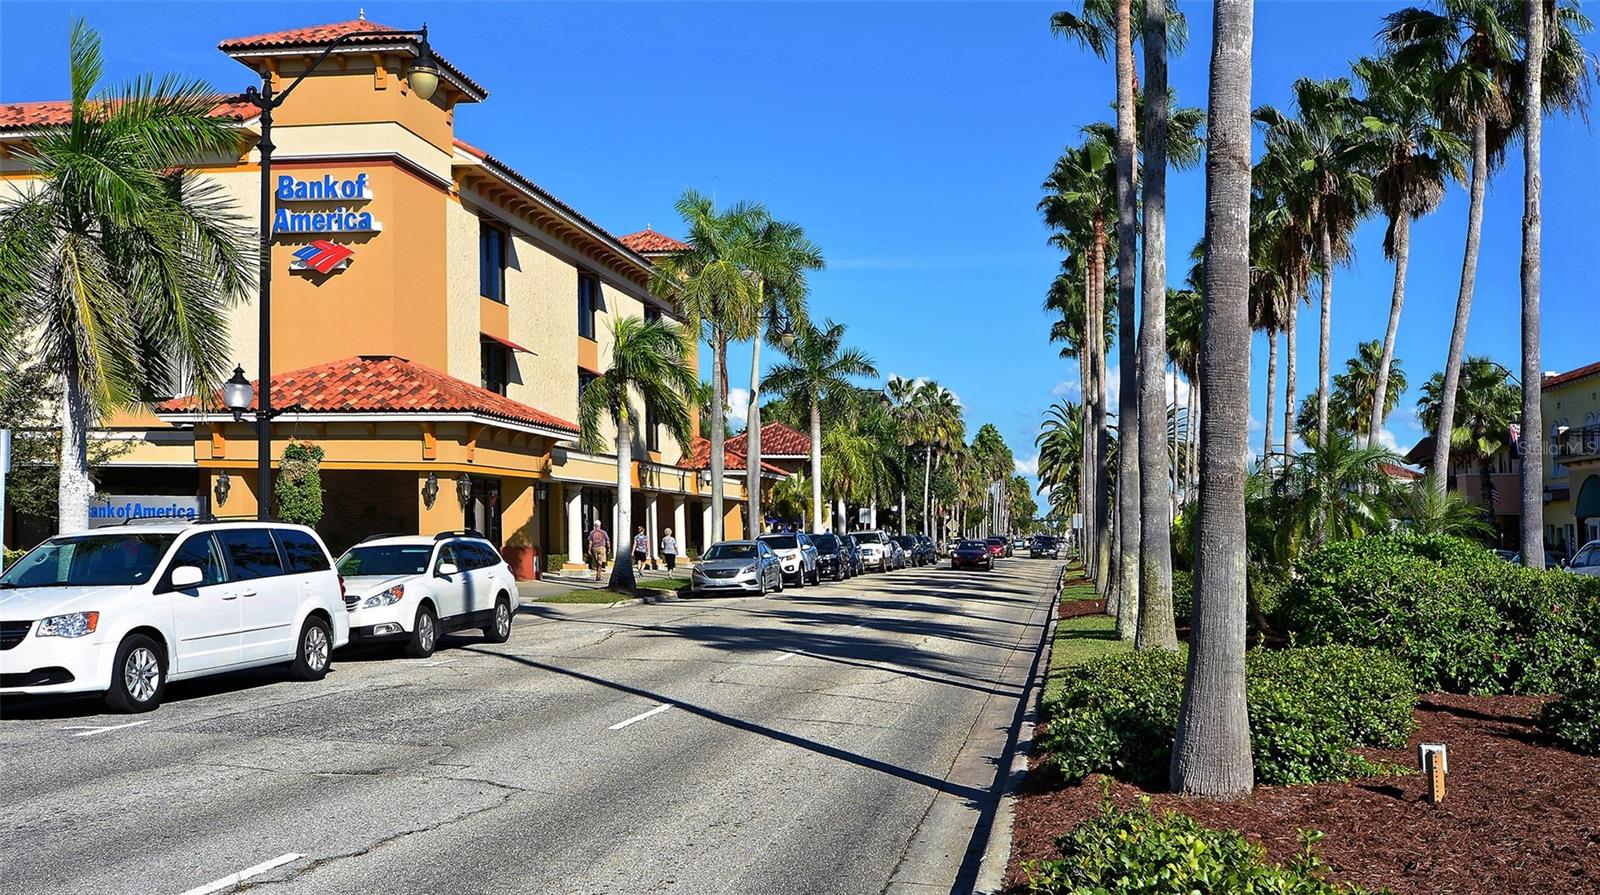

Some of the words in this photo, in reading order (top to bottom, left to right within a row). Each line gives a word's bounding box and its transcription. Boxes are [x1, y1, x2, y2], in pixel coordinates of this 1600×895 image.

[278, 174, 340, 199] Bank
[341, 173, 368, 199] of
[274, 206, 373, 233] America
[88, 501, 115, 518] ank
[116, 503, 131, 518] of
[133, 503, 196, 519] America
